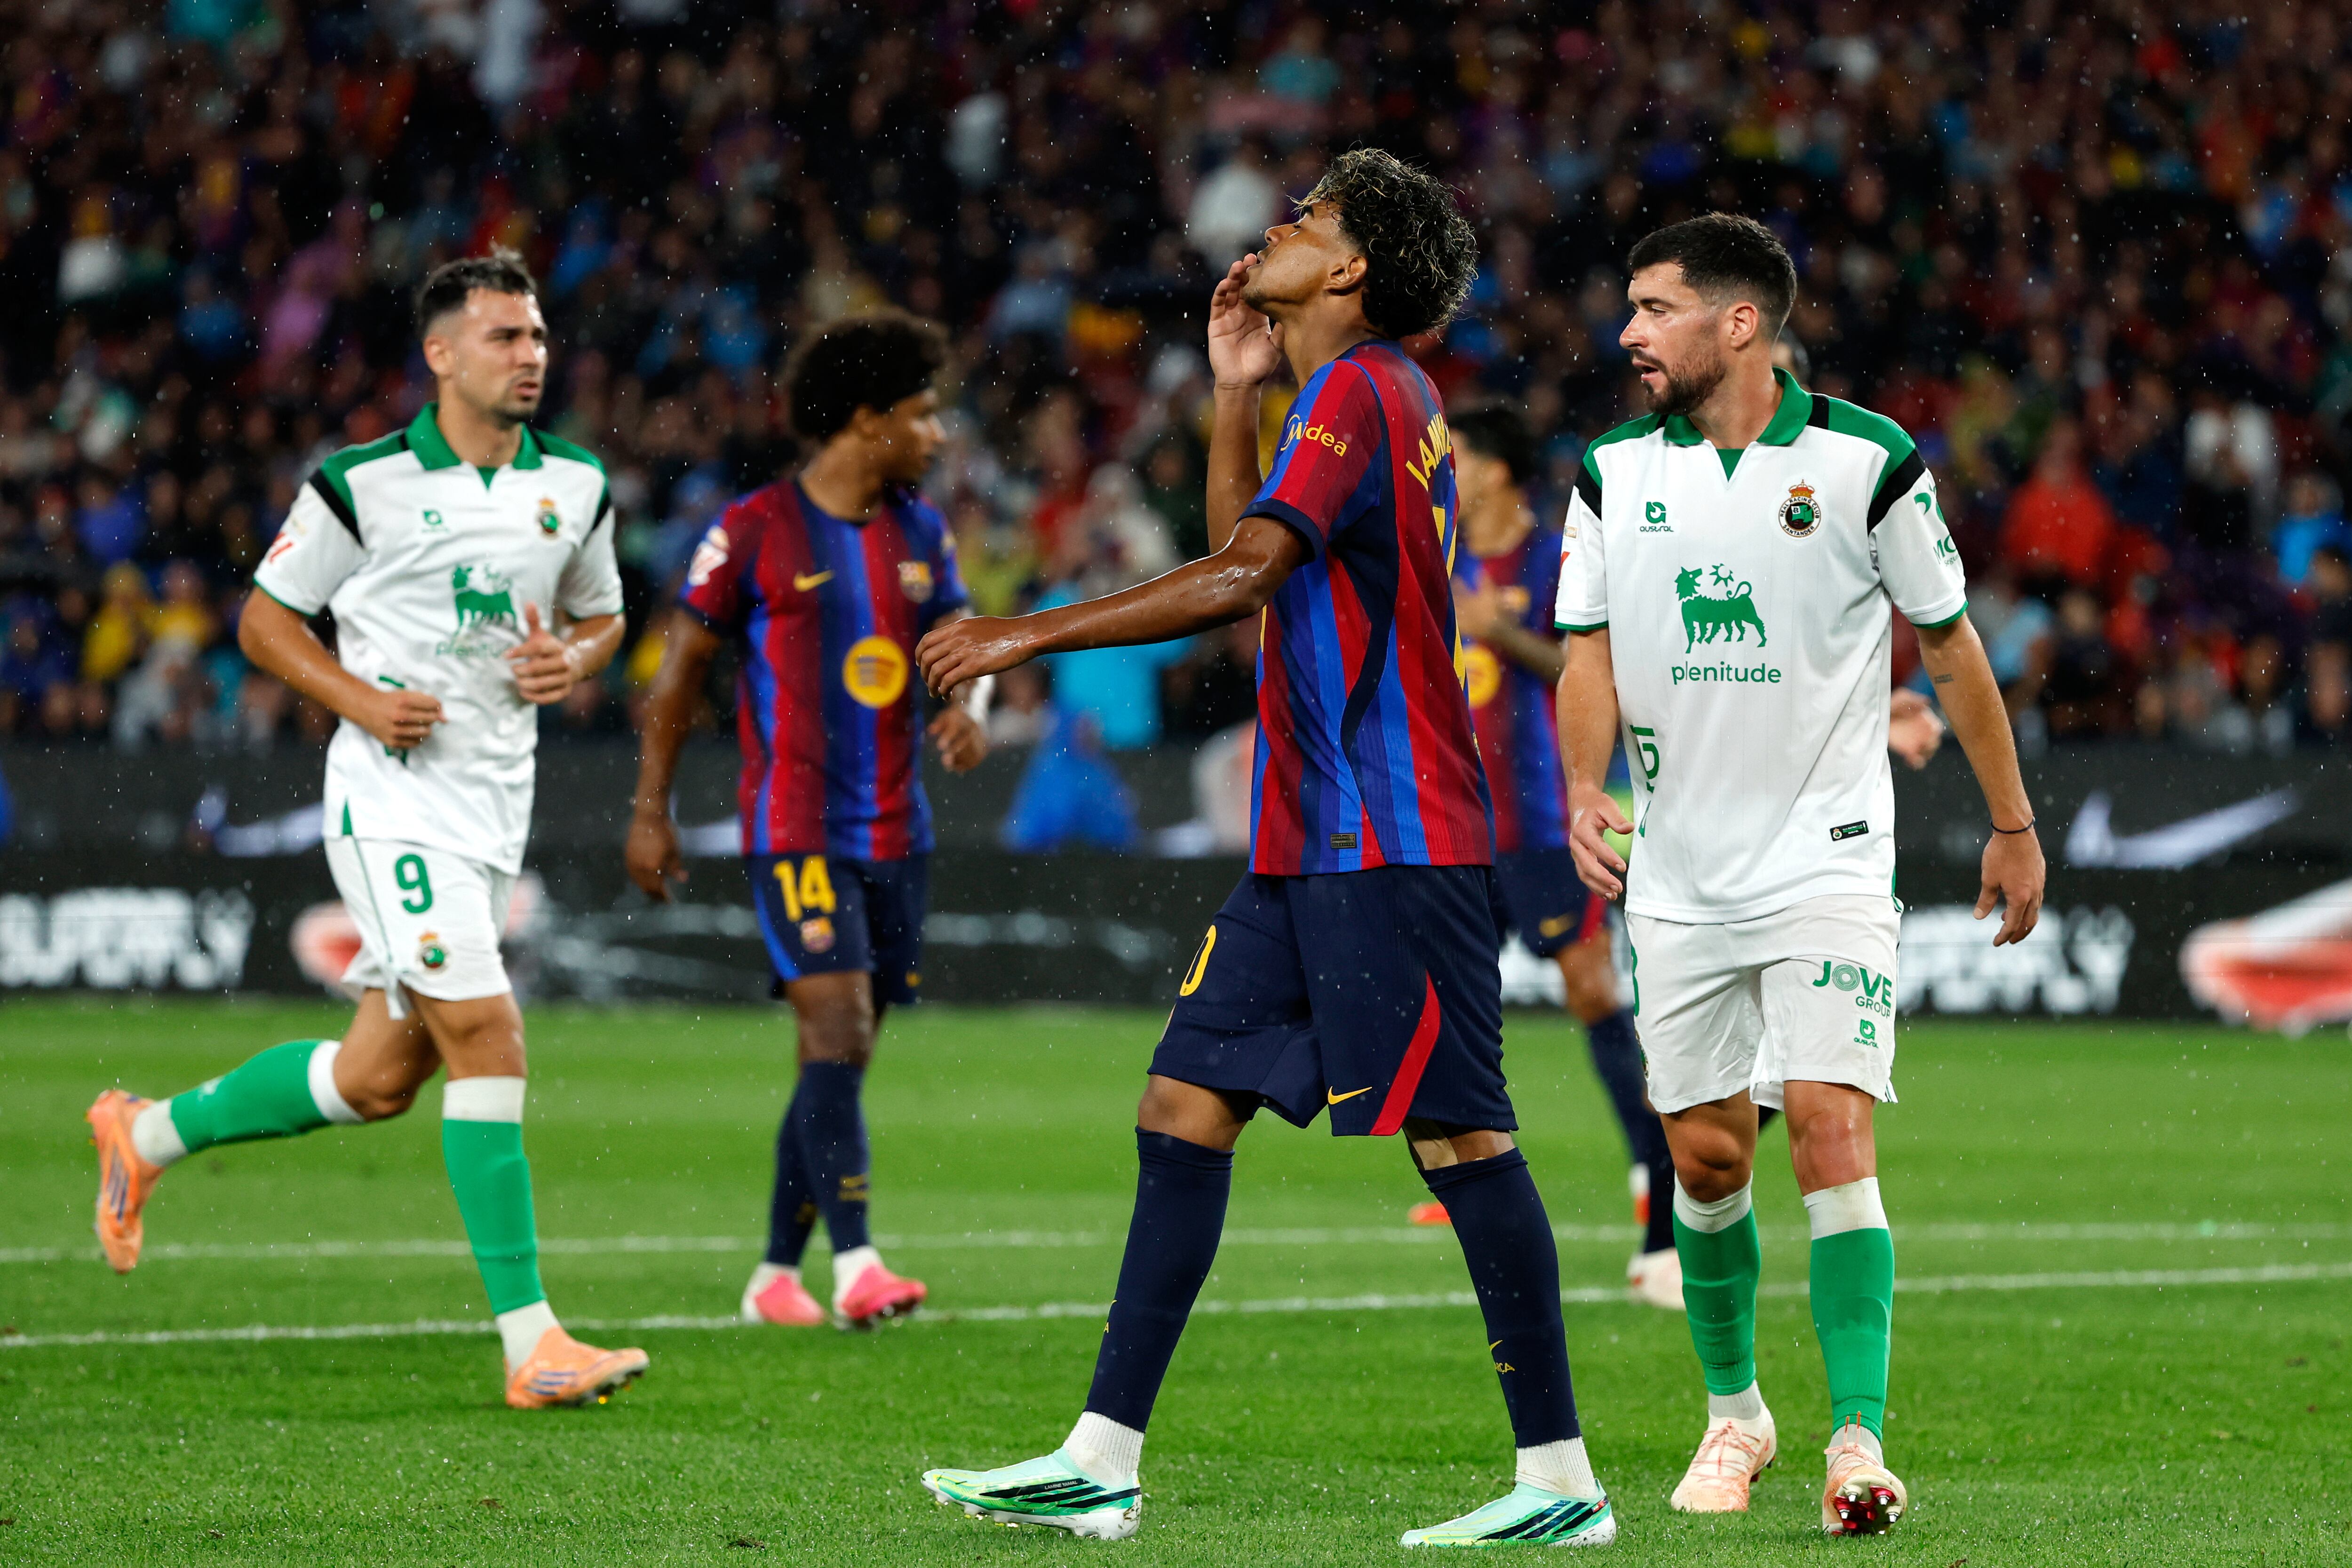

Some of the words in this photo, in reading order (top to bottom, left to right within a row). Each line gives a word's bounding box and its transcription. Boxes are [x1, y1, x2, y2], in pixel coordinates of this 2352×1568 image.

[1280, 414, 1347, 457] Midea
[1780, 503, 1789, 517] REAL
[1783, 525, 1814, 536] SANTANDER
[1671, 661, 1781, 685] plenitude
[396, 854, 433, 914] 9
[772, 854, 837, 923] 14
[1812, 961, 1892, 1009] JOVE
[1856, 996, 1890, 1018] GROUP
